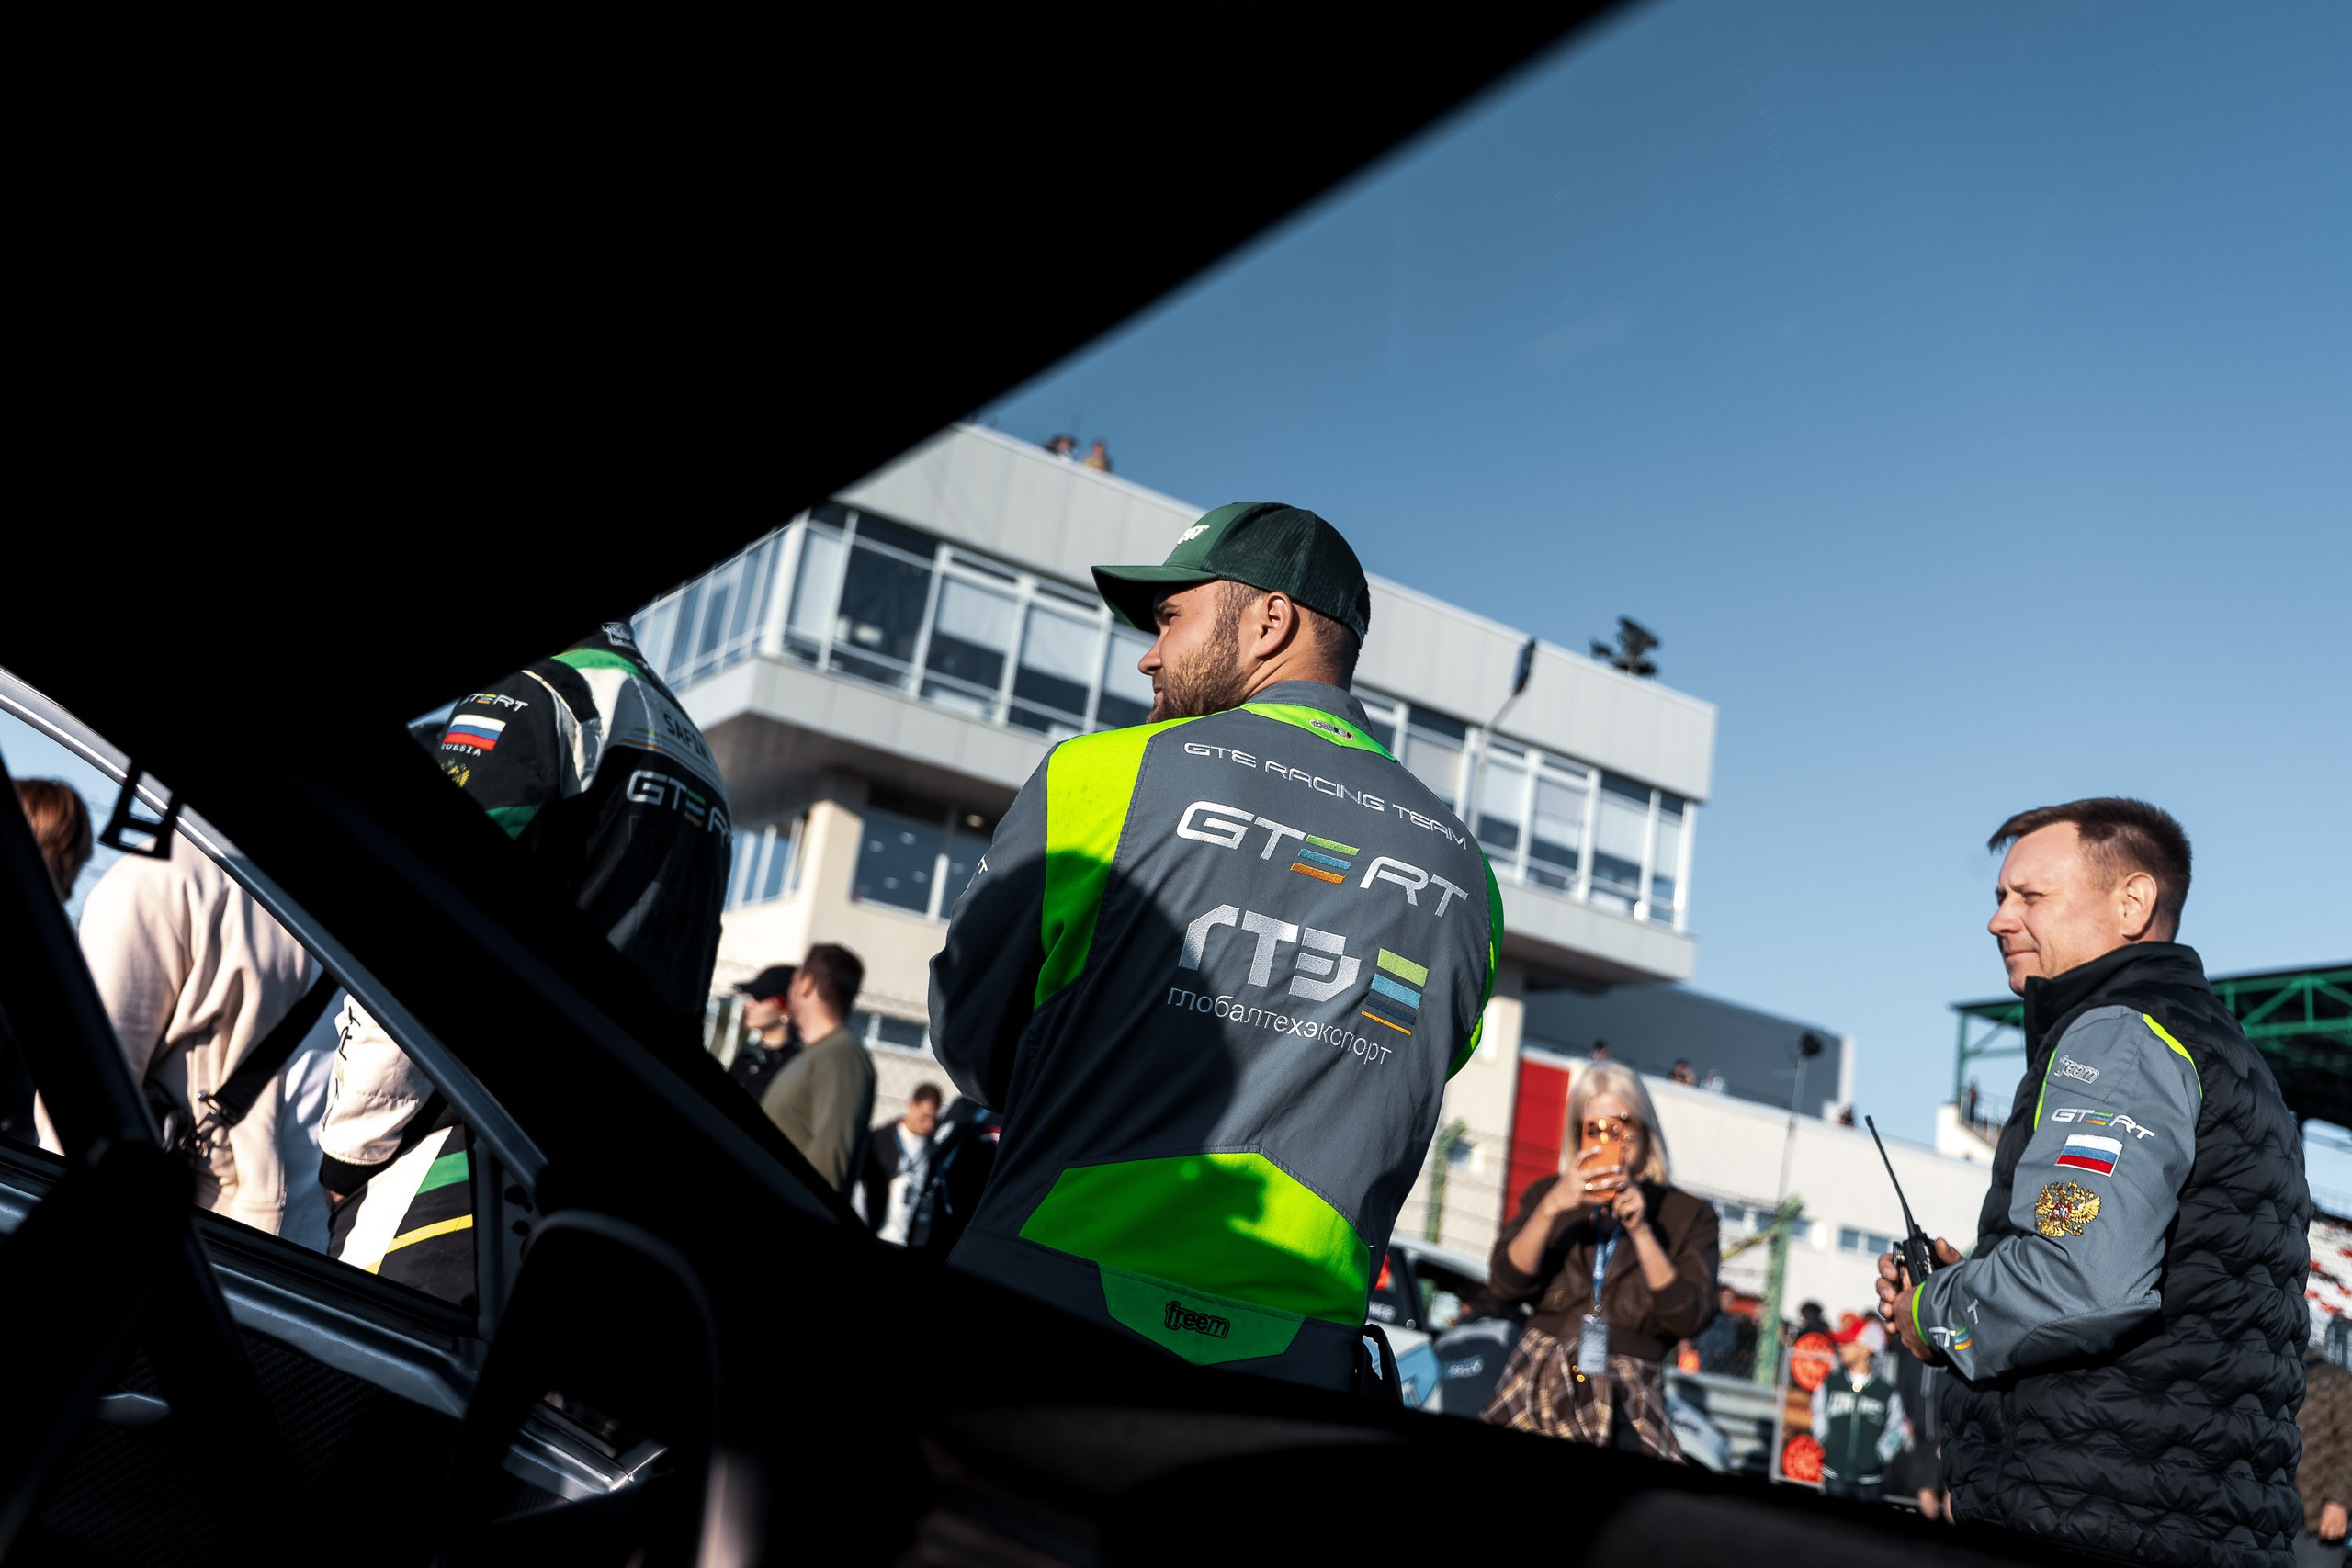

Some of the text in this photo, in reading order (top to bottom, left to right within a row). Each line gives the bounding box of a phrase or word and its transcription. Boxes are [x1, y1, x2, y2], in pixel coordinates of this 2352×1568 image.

[627, 770, 733, 846] GTER
[1183, 741, 1468, 851] GTE RACING TEAM
[1176, 800, 1469, 918] GTERT
[1166, 987, 1393, 1066] глобалтехэкспорт
[2051, 1107, 2156, 1140] GTERT
[1165, 1301, 1231, 1339] freem
